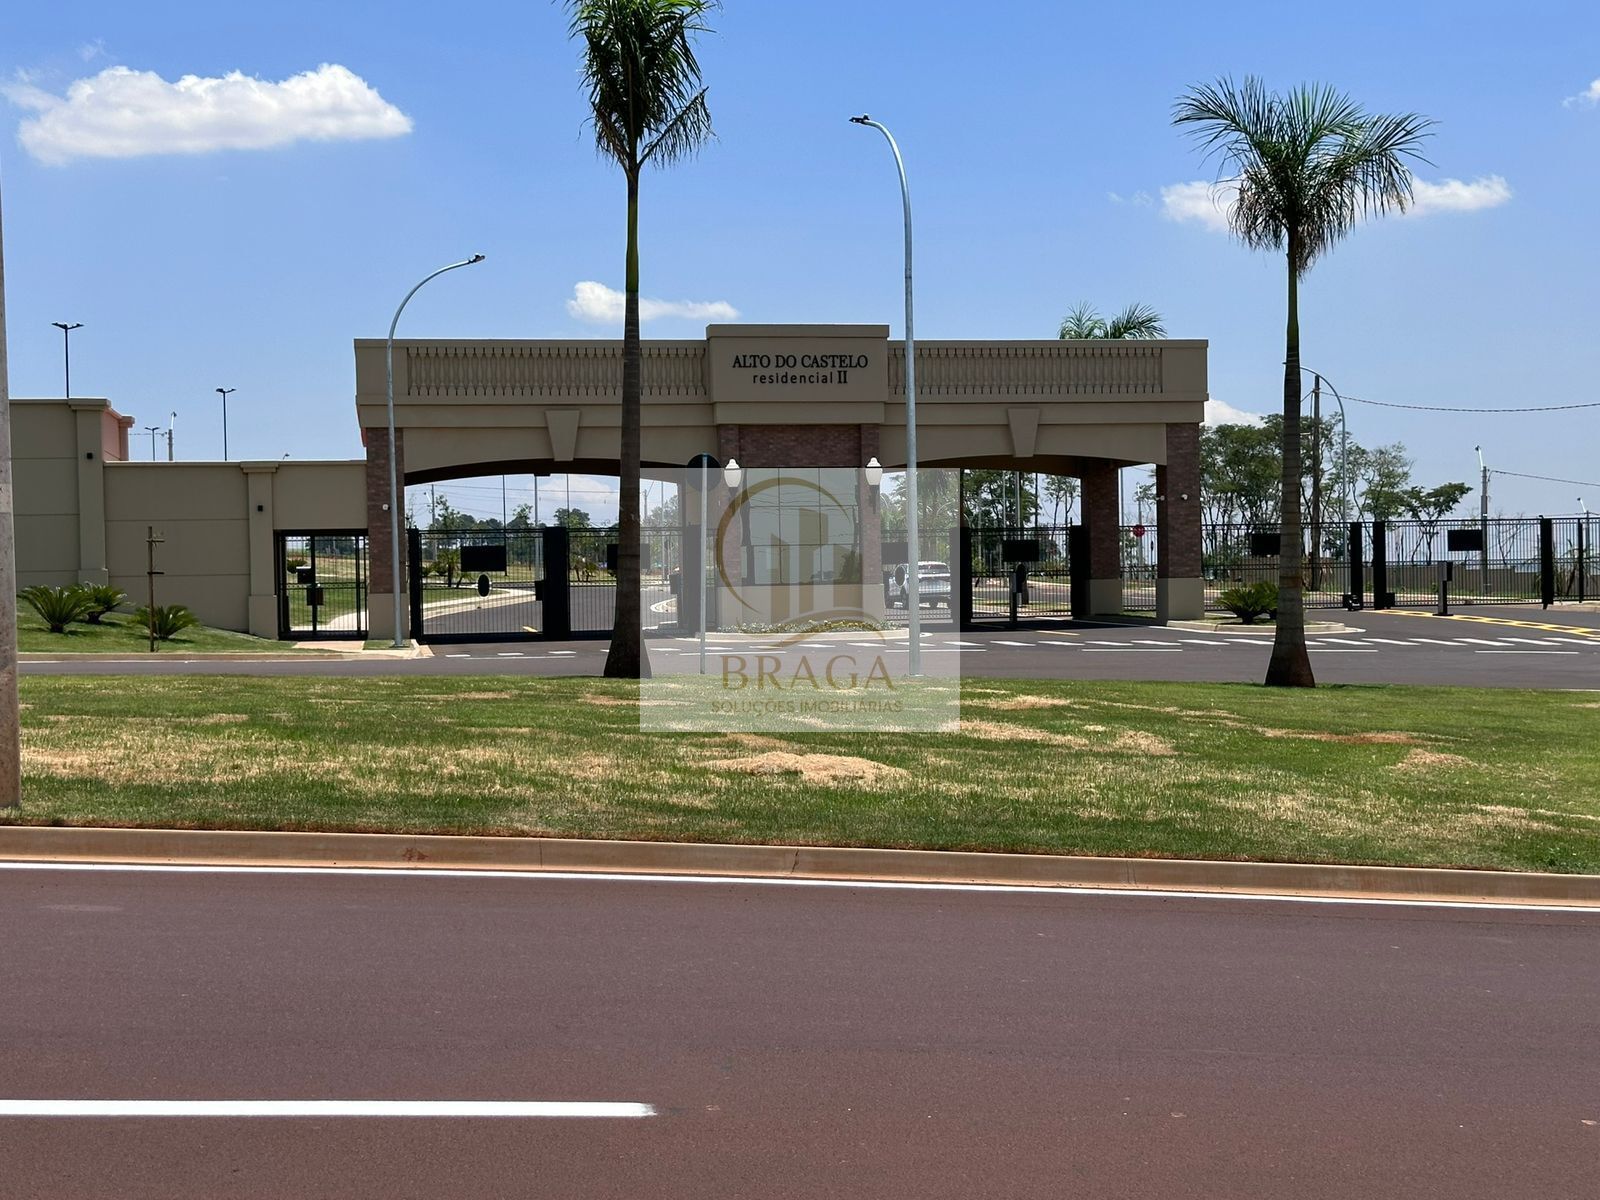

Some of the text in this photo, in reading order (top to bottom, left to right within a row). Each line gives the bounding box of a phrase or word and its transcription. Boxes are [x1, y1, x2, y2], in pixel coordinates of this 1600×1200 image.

[732, 354, 869, 369] ALTO DO CASTELO
[753, 370, 848, 384] residencial II
